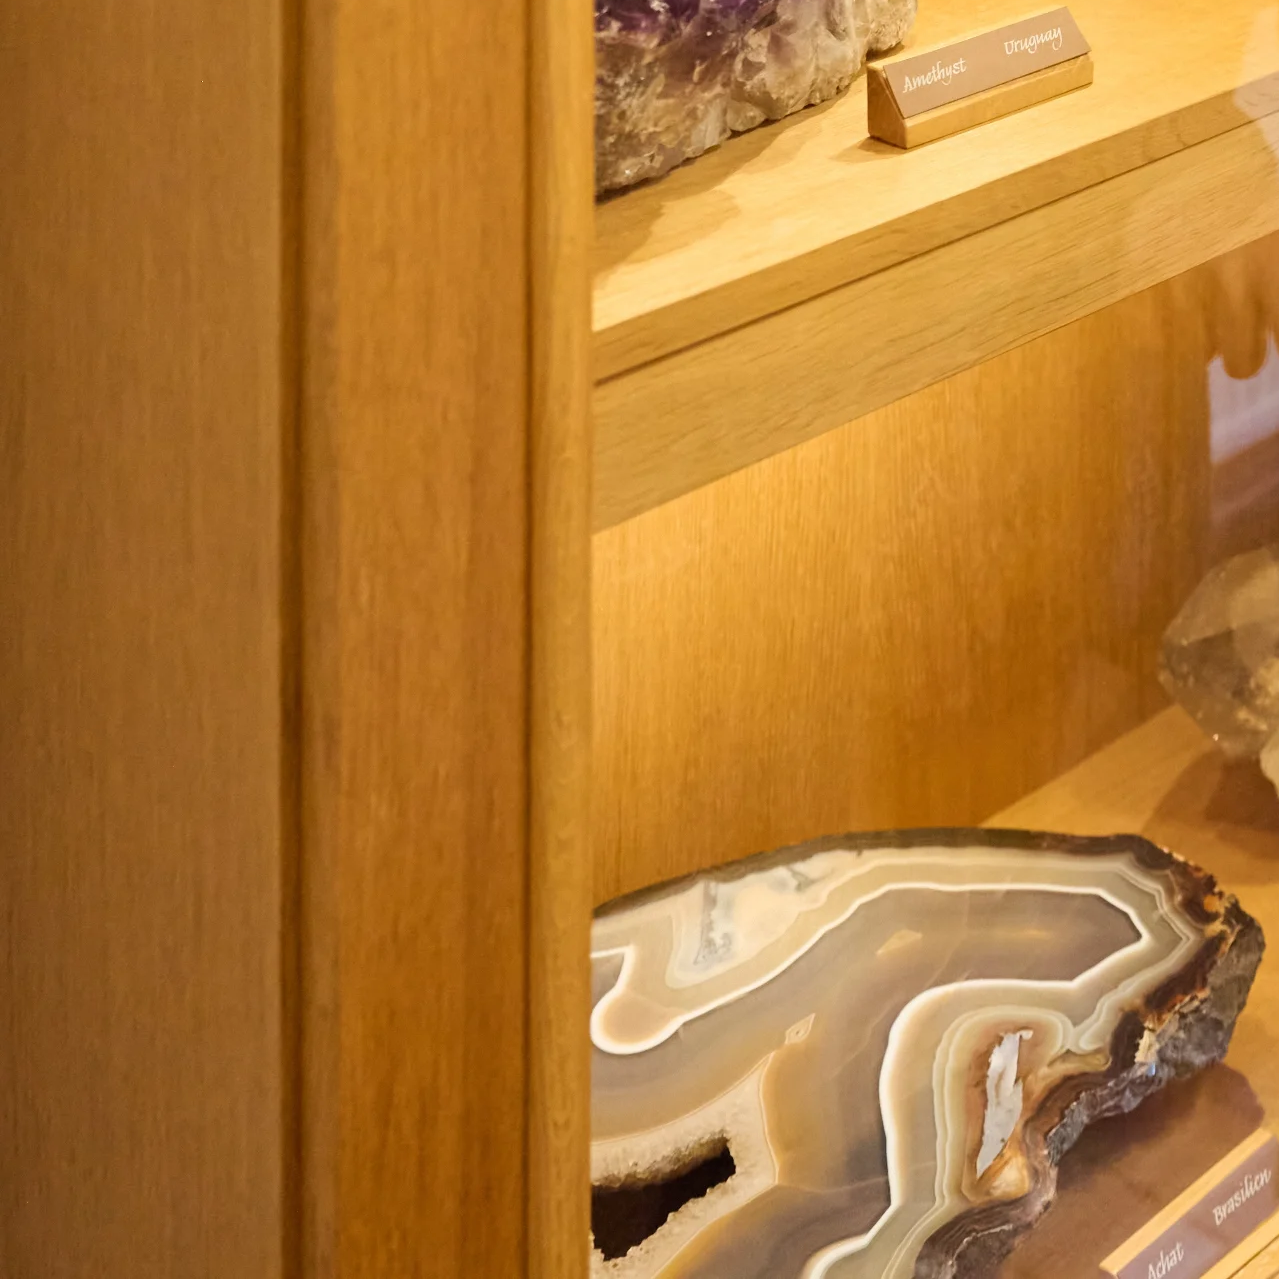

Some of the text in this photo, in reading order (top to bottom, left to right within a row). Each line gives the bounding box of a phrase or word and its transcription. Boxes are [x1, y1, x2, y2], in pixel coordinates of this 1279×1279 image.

[902, 26, 1063, 94] Amethyst Uruguay
[1146, 1167, 1272, 1279] Achat Brasilien
